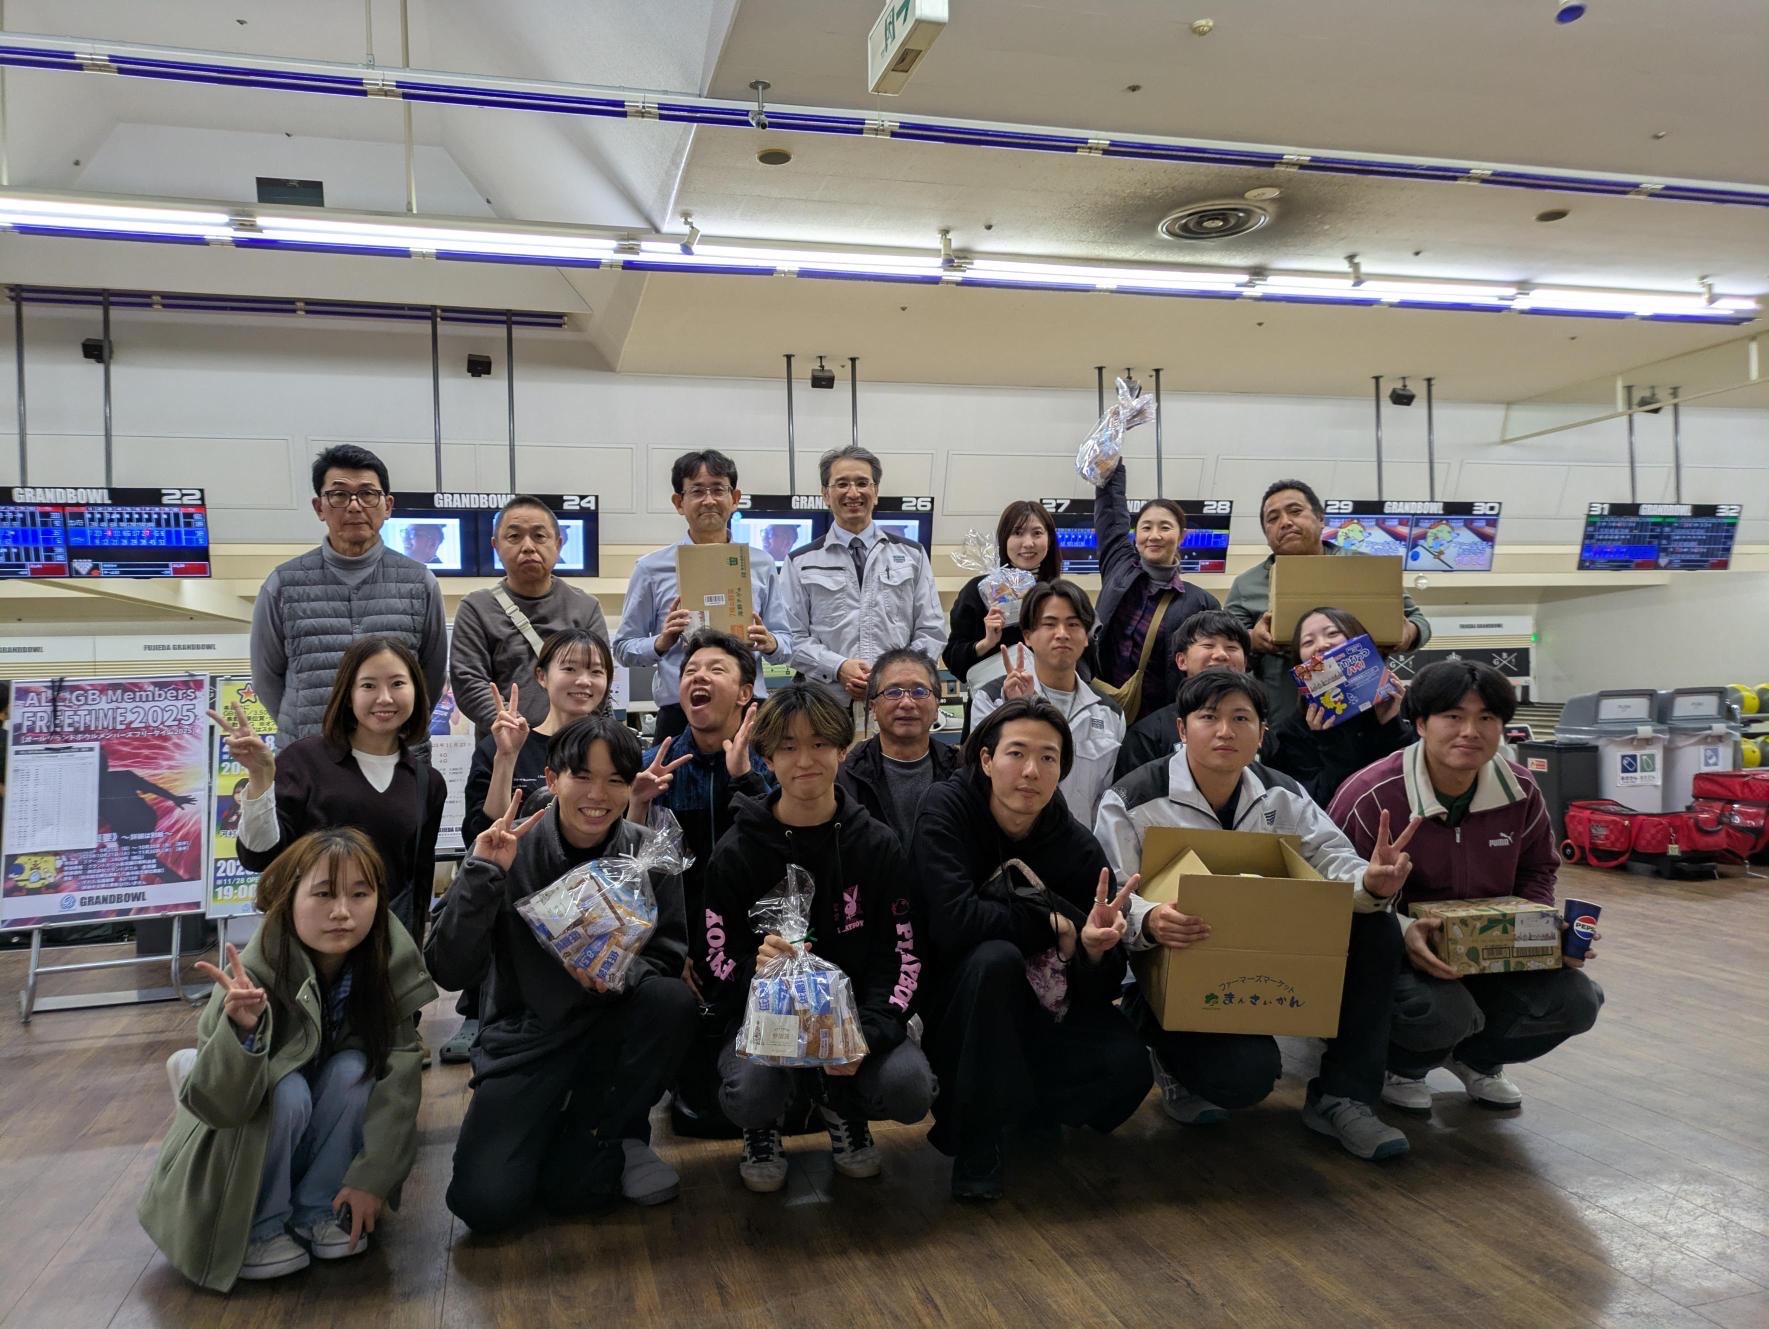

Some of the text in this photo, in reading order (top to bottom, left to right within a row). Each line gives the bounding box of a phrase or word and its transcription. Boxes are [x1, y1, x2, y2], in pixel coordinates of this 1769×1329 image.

[12, 488, 112, 503] GRANDBOWL
[161, 489, 202, 504] 22
[434, 494, 516, 508] GRANDBOW
[562, 495, 596, 510] 24
[901, 497, 932, 511] 26
[1042, 500, 1071, 513] 27
[1203, 501, 1231, 514] 28
[1326, 501, 1353, 513] 29
[1384, 502, 1445, 514] GRANDBOWL
[1472, 503, 1500, 514] 30
[1589, 504, 1610, 515] 31
[1715, 505, 1741, 516] 32
[106, 687, 196, 704] Members
[130, 704, 197, 727] 2025
[79, 892, 147, 907] GRANDBOWL
